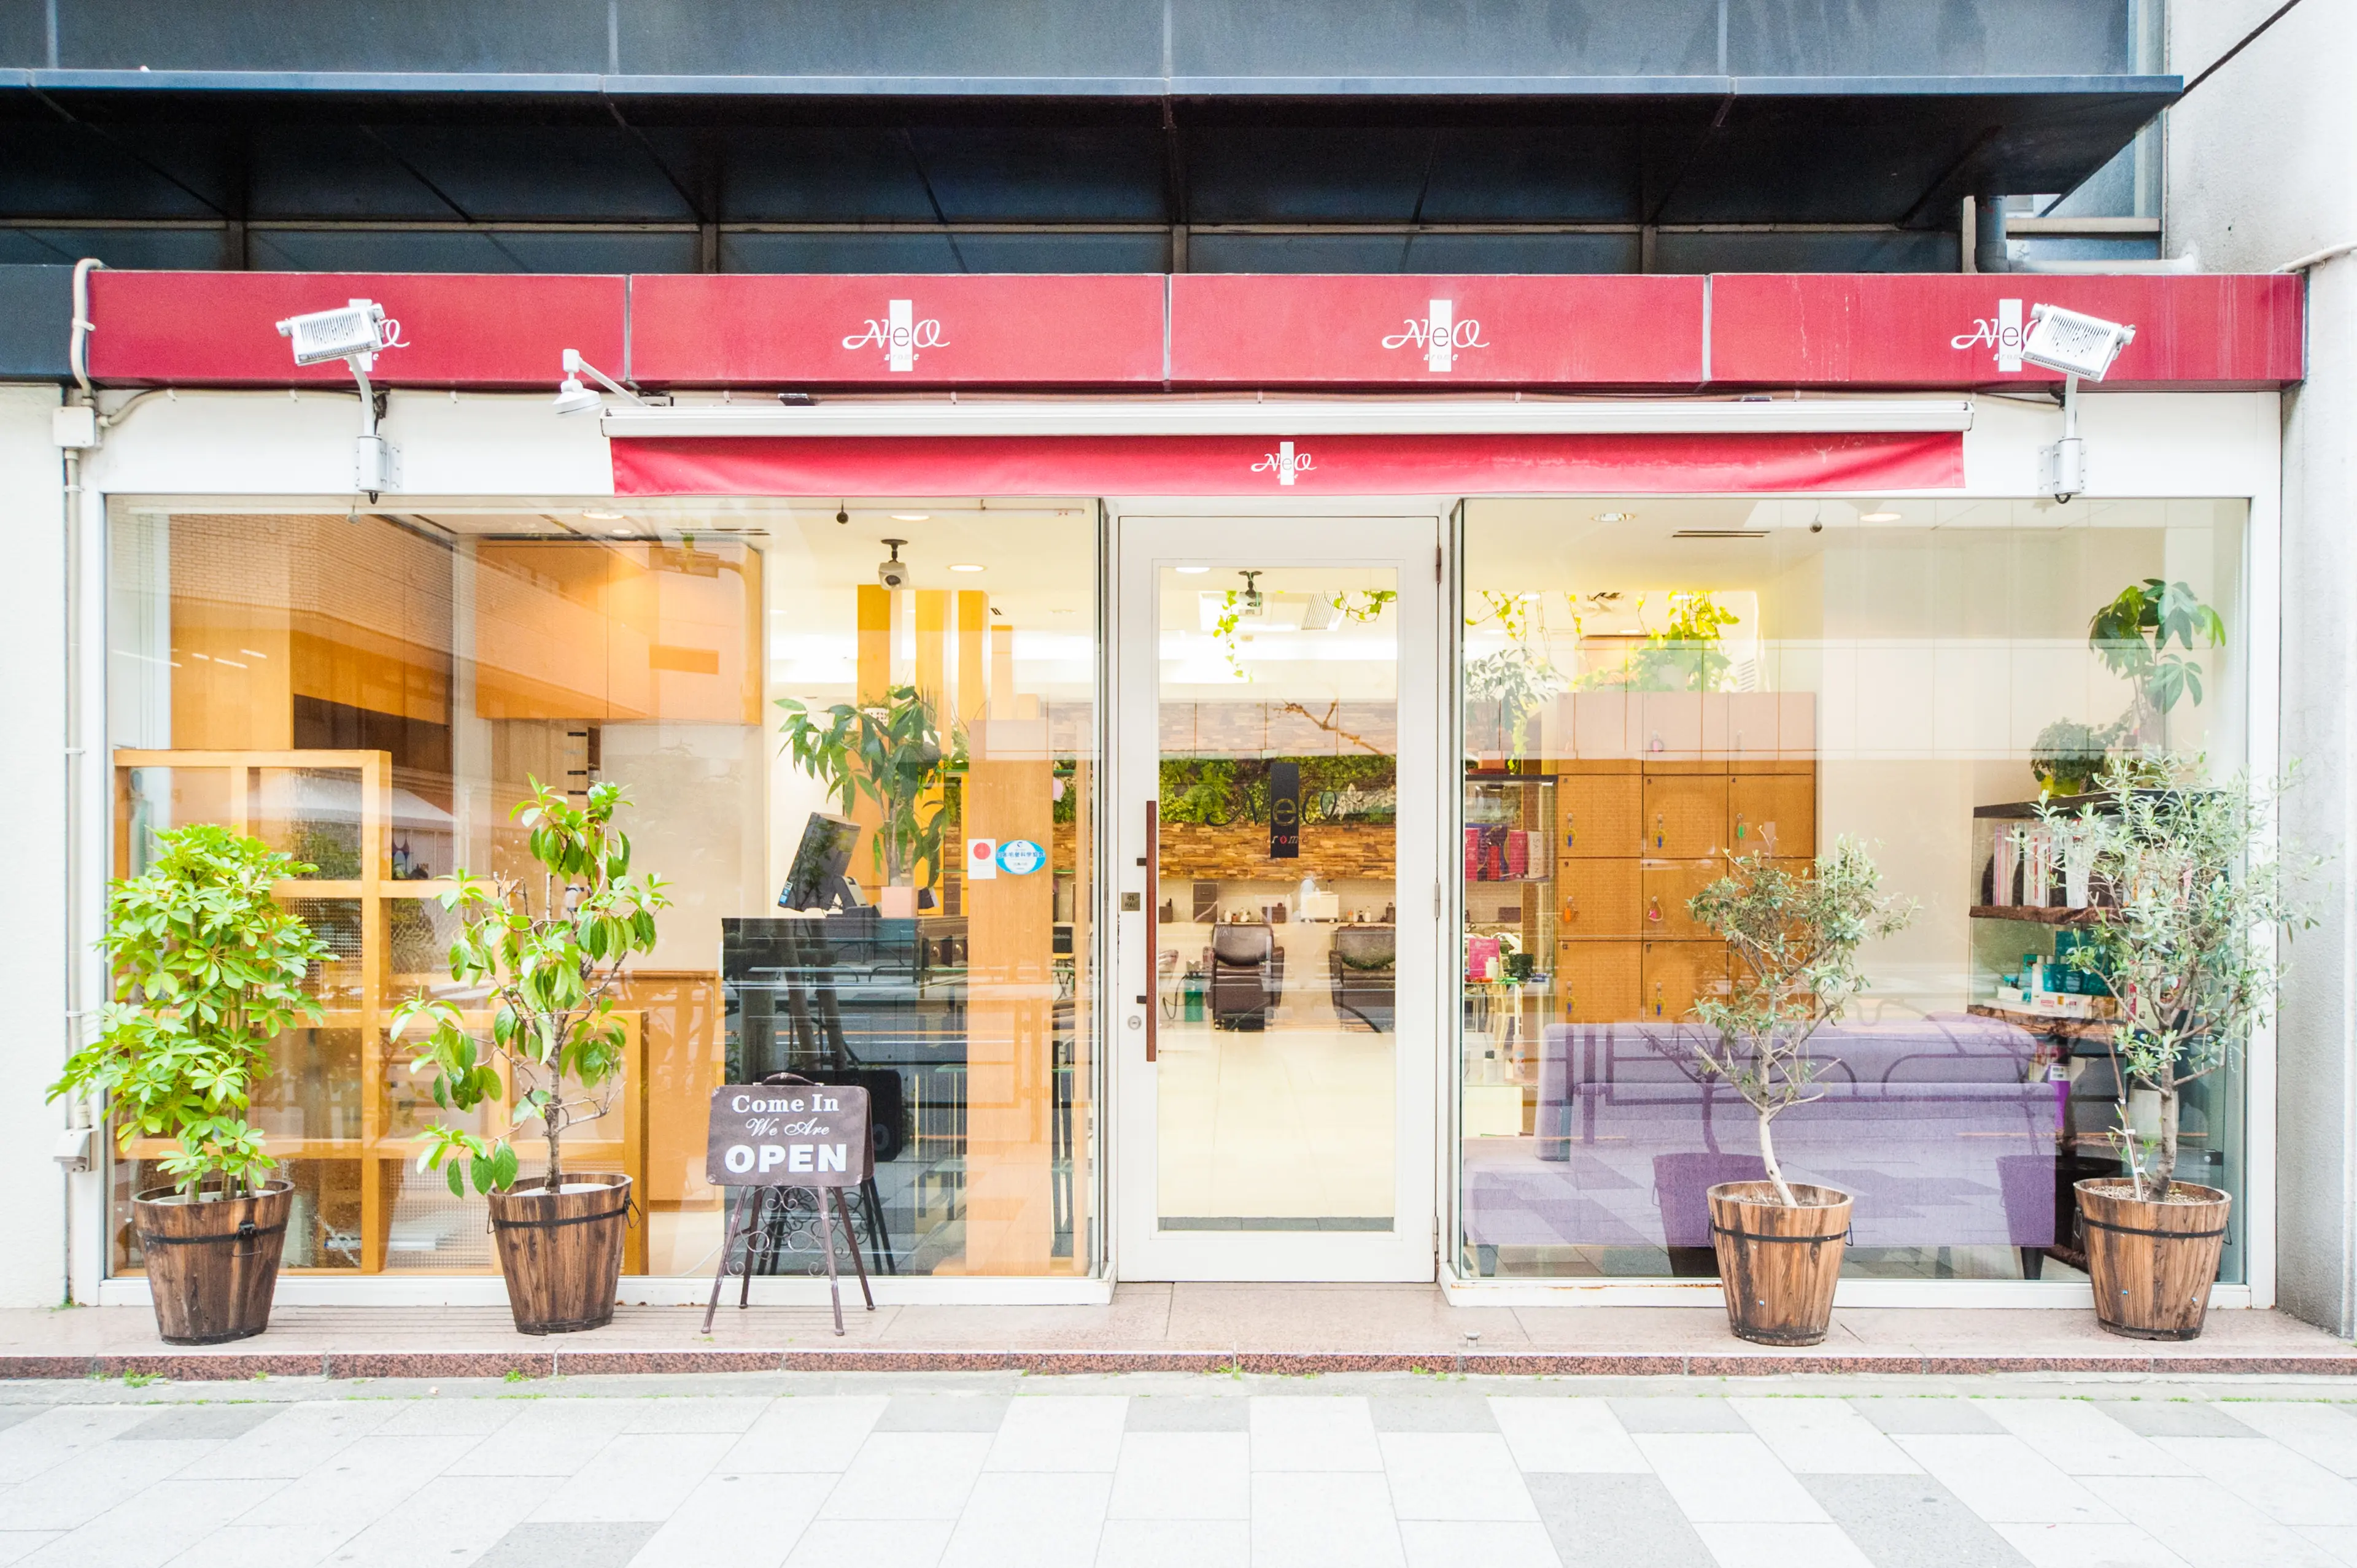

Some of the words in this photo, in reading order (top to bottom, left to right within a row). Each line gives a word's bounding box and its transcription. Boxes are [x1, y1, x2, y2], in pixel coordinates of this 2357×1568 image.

[732, 1095, 804, 1113] Come
[811, 1094, 839, 1112] In
[746, 1118, 780, 1137] We
[784, 1117, 830, 1136] Are
[724, 1144, 847, 1173] OPEN
